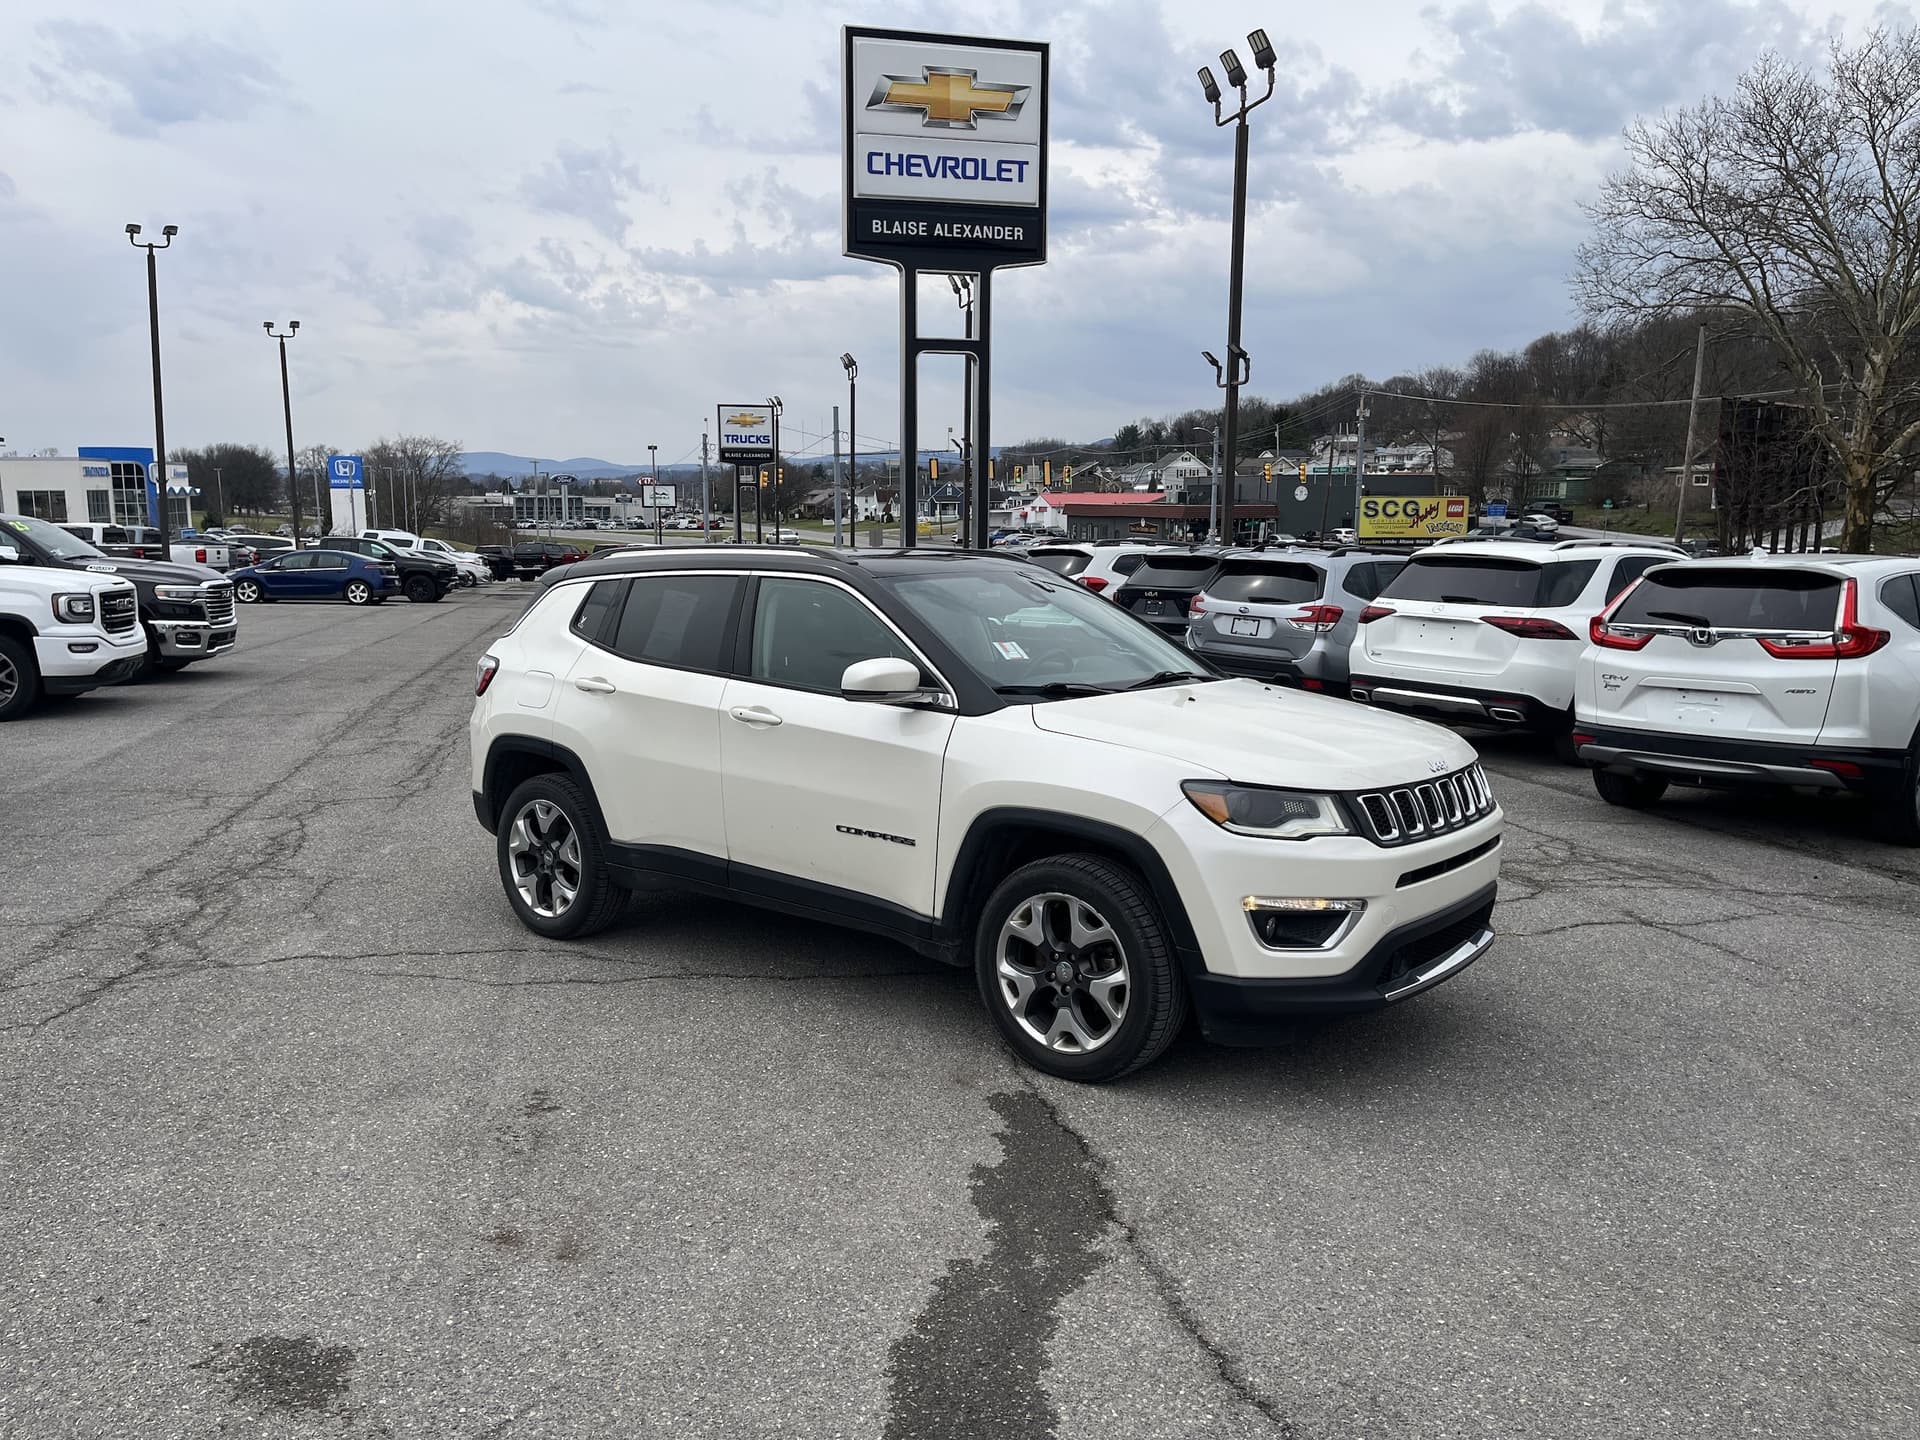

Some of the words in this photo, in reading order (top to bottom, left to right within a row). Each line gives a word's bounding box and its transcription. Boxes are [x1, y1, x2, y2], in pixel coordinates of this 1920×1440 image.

[867, 151, 1029, 183] CHEVROLET
[872, 219, 928, 236] BLAISE
[934, 222, 1024, 241] ALEXANDER
[724, 434, 771, 444] TRUCKS
[1363, 500, 1420, 518] SCG
[836, 824, 916, 847] COMPASS
